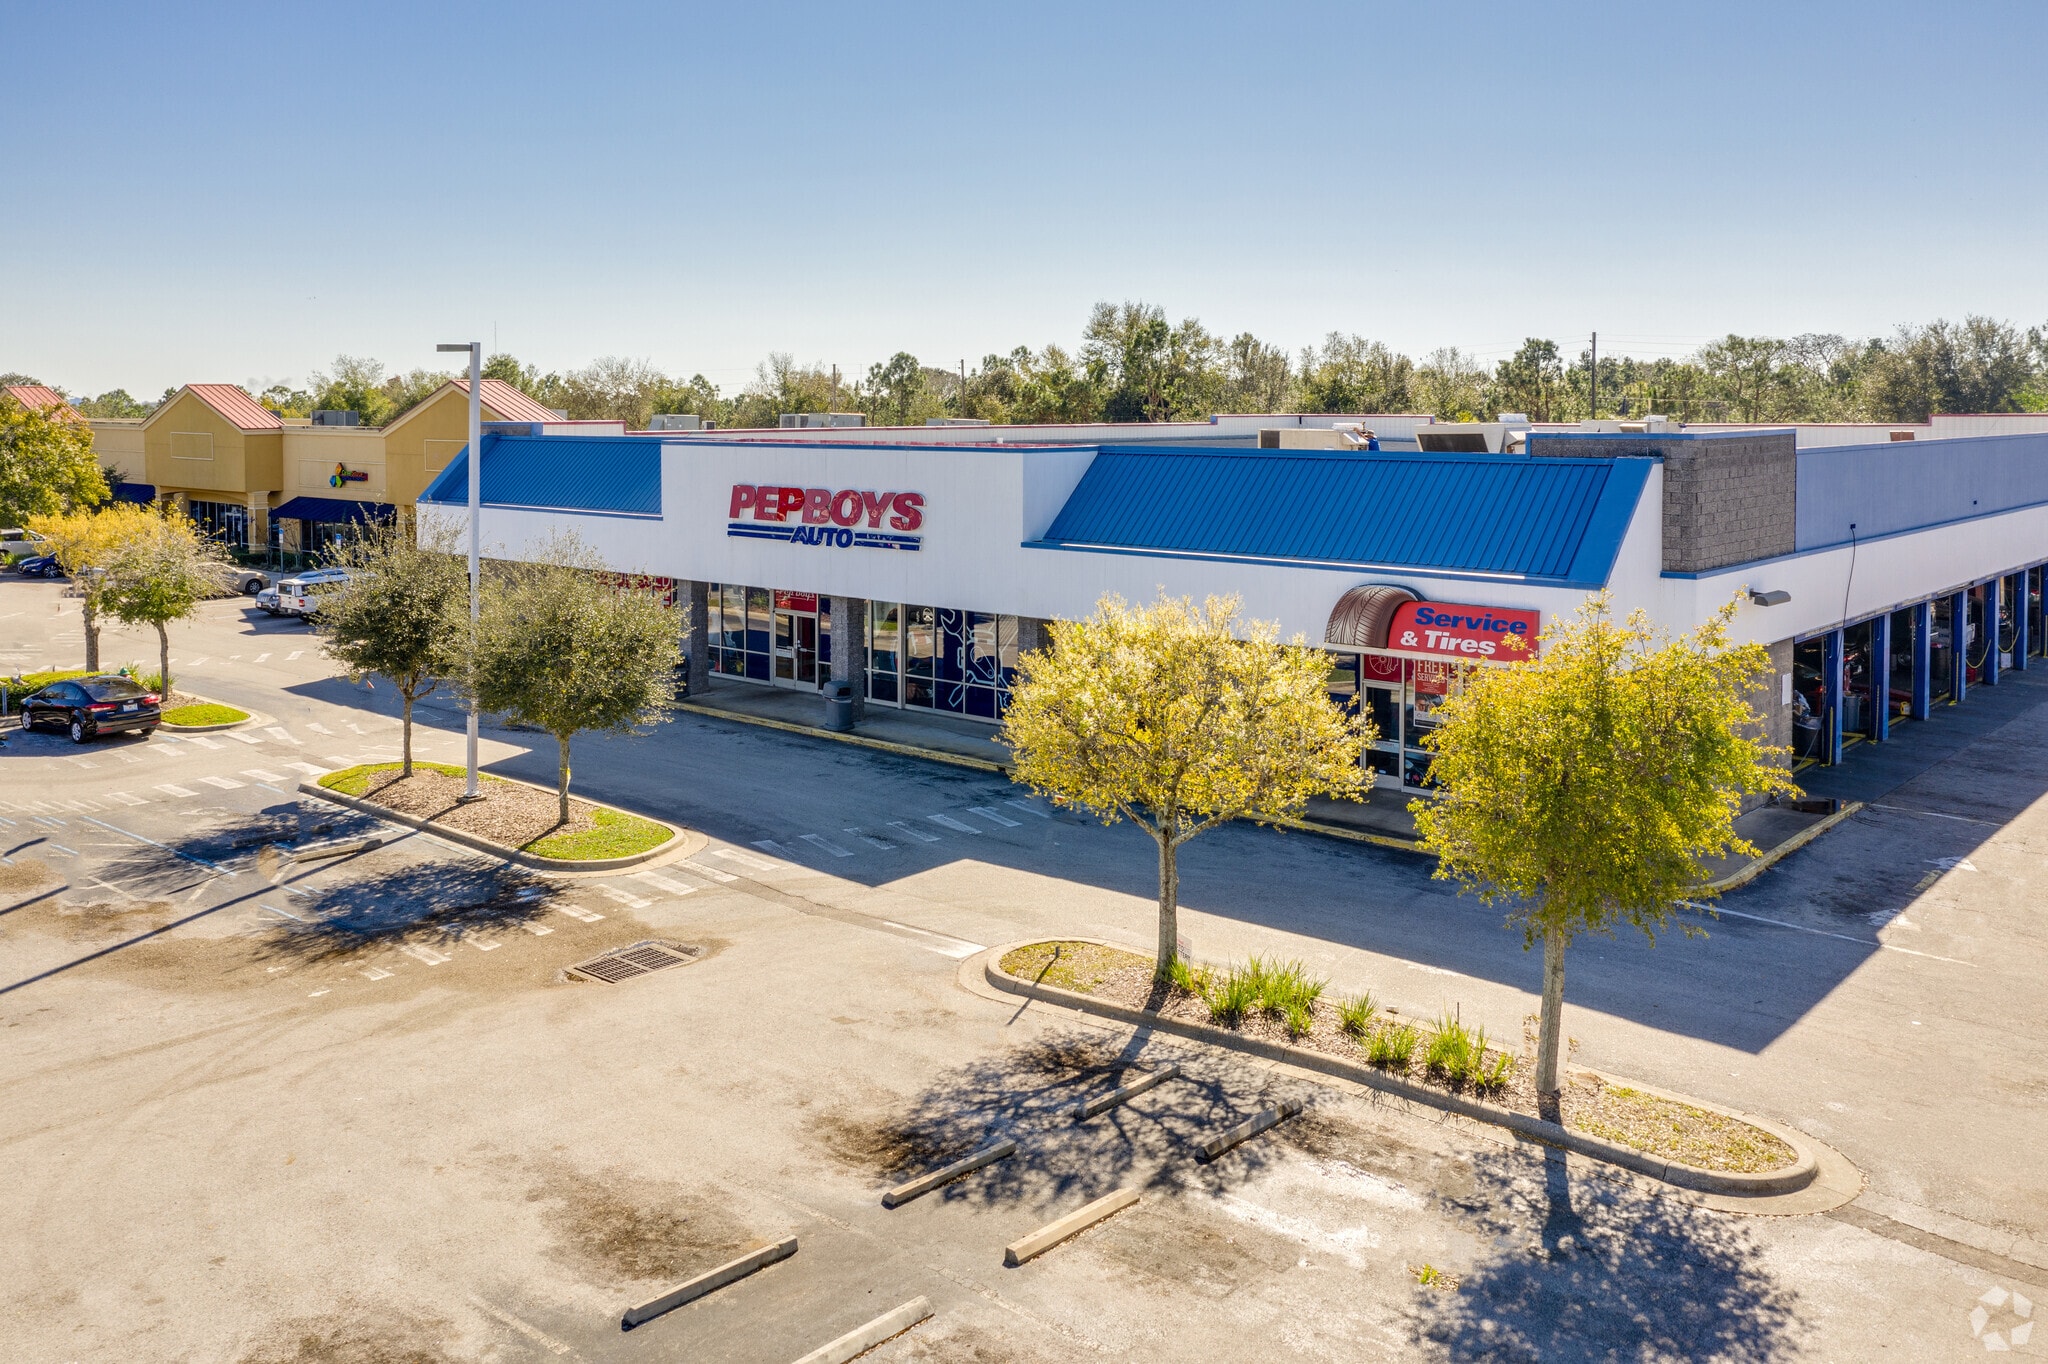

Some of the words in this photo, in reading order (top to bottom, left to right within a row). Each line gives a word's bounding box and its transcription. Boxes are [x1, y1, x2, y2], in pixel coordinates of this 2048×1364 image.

[790, 526, 854, 548] AUTO
[1415, 607, 1528, 635] Service
[1400, 630, 1418, 647] &
[1424, 630, 1496, 655] Tires
[1417, 660, 1445, 675] FREE
